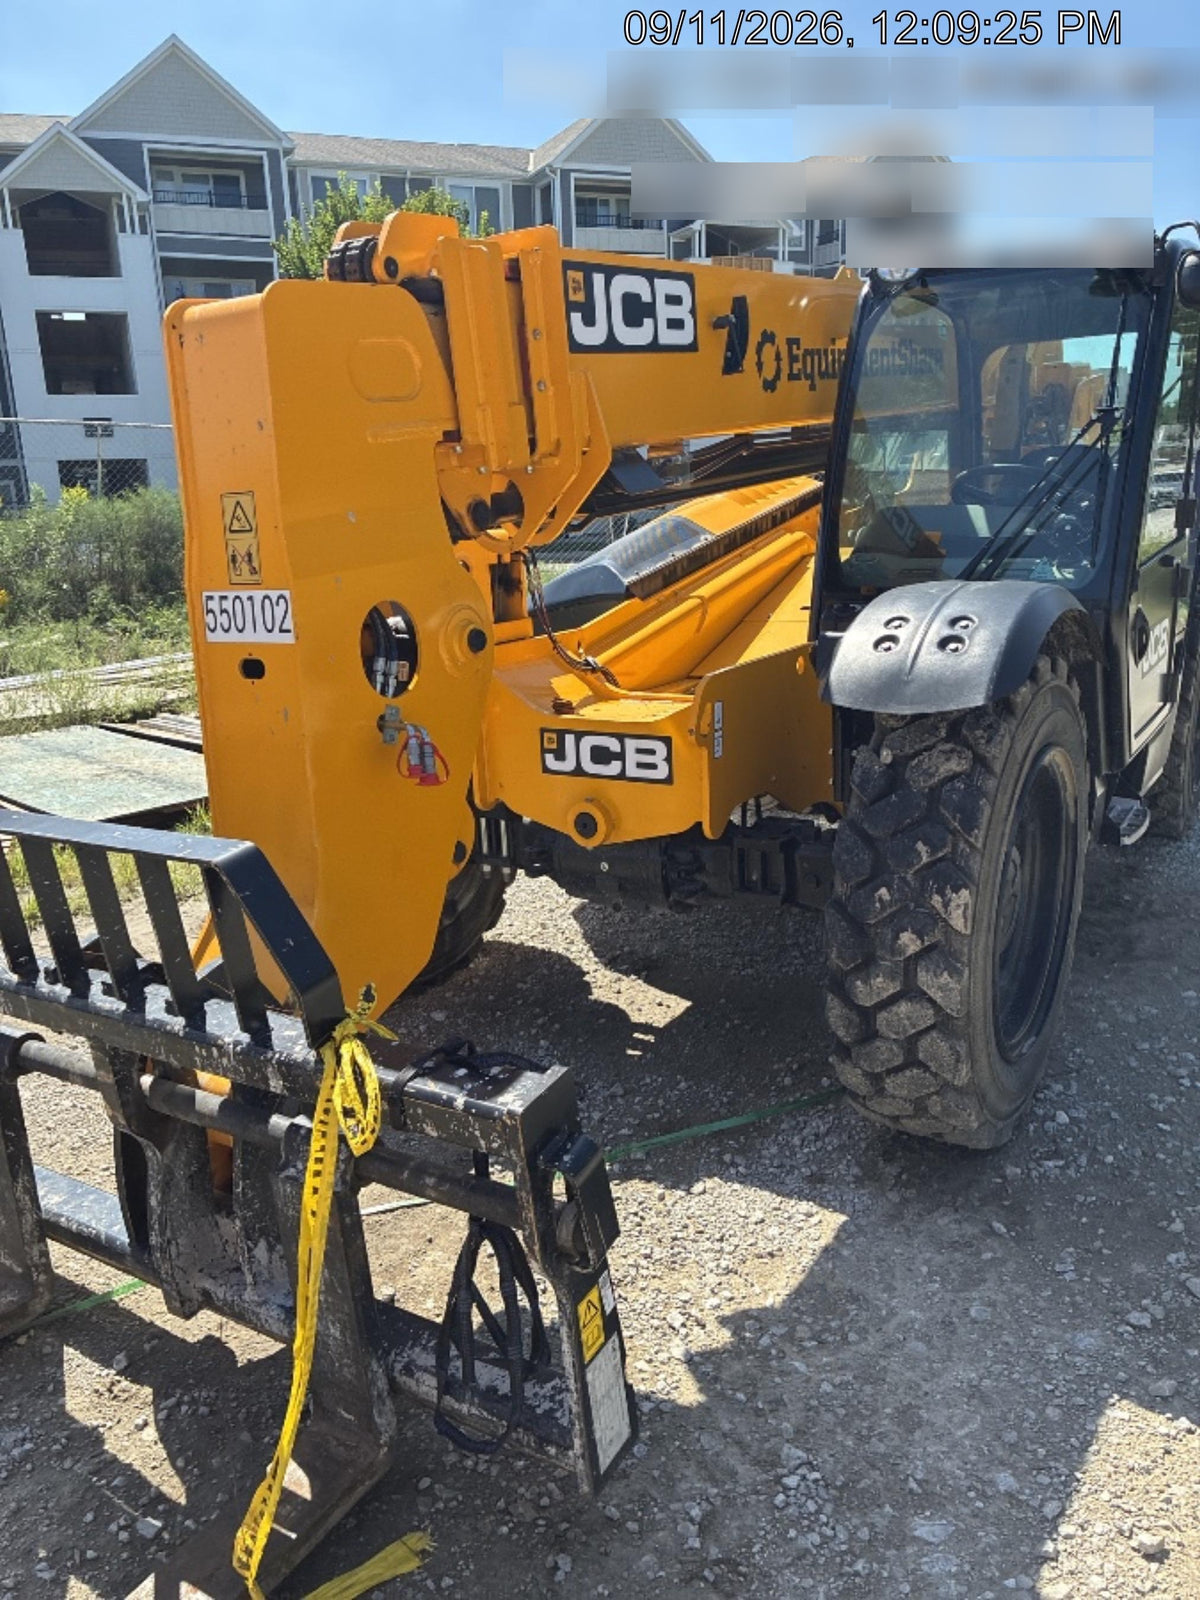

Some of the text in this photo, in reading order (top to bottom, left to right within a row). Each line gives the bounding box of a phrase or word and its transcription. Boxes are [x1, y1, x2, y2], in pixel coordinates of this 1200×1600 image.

[570, 272, 694, 346] JCB
[205, 594, 292, 634] 550102
[544, 733, 670, 780] JCB
